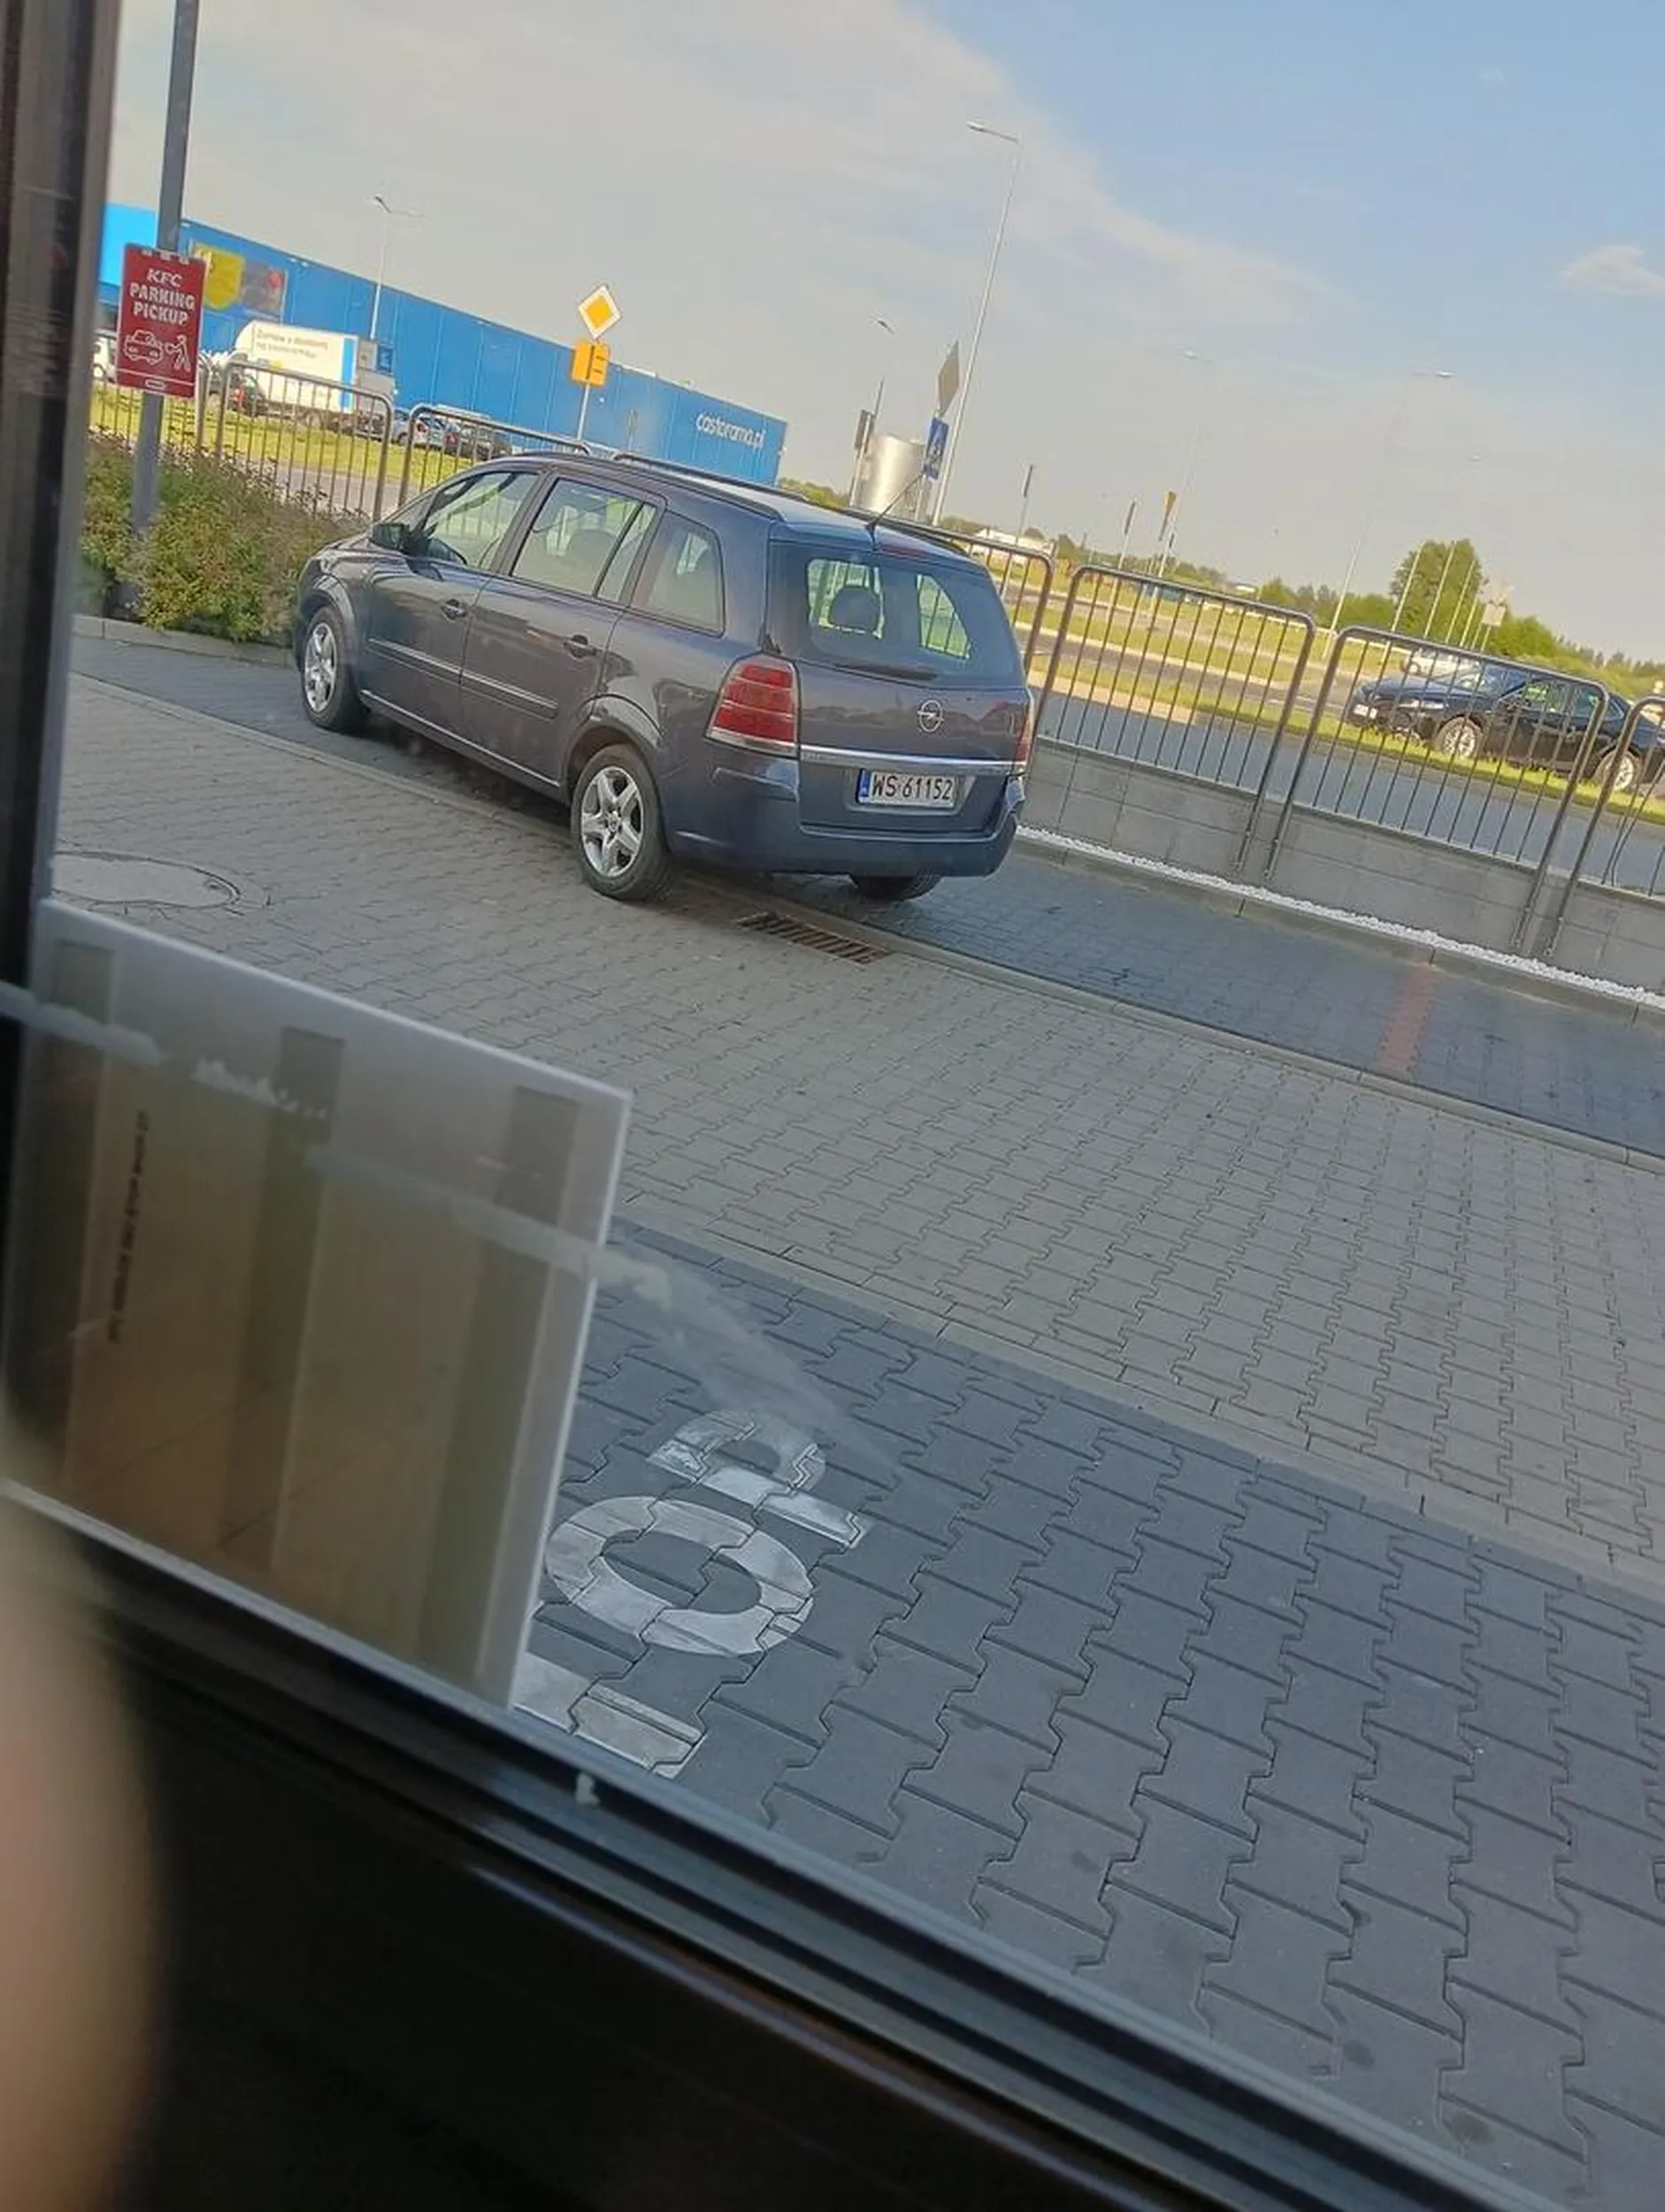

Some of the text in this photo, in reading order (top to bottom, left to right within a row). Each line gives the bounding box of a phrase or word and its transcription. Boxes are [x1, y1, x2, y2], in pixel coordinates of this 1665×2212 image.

[147, 268, 183, 288] KFC
[129, 282, 196, 311] PARKING
[133, 302, 188, 327] PICKUP
[871, 775, 953, 800] WS 61152
